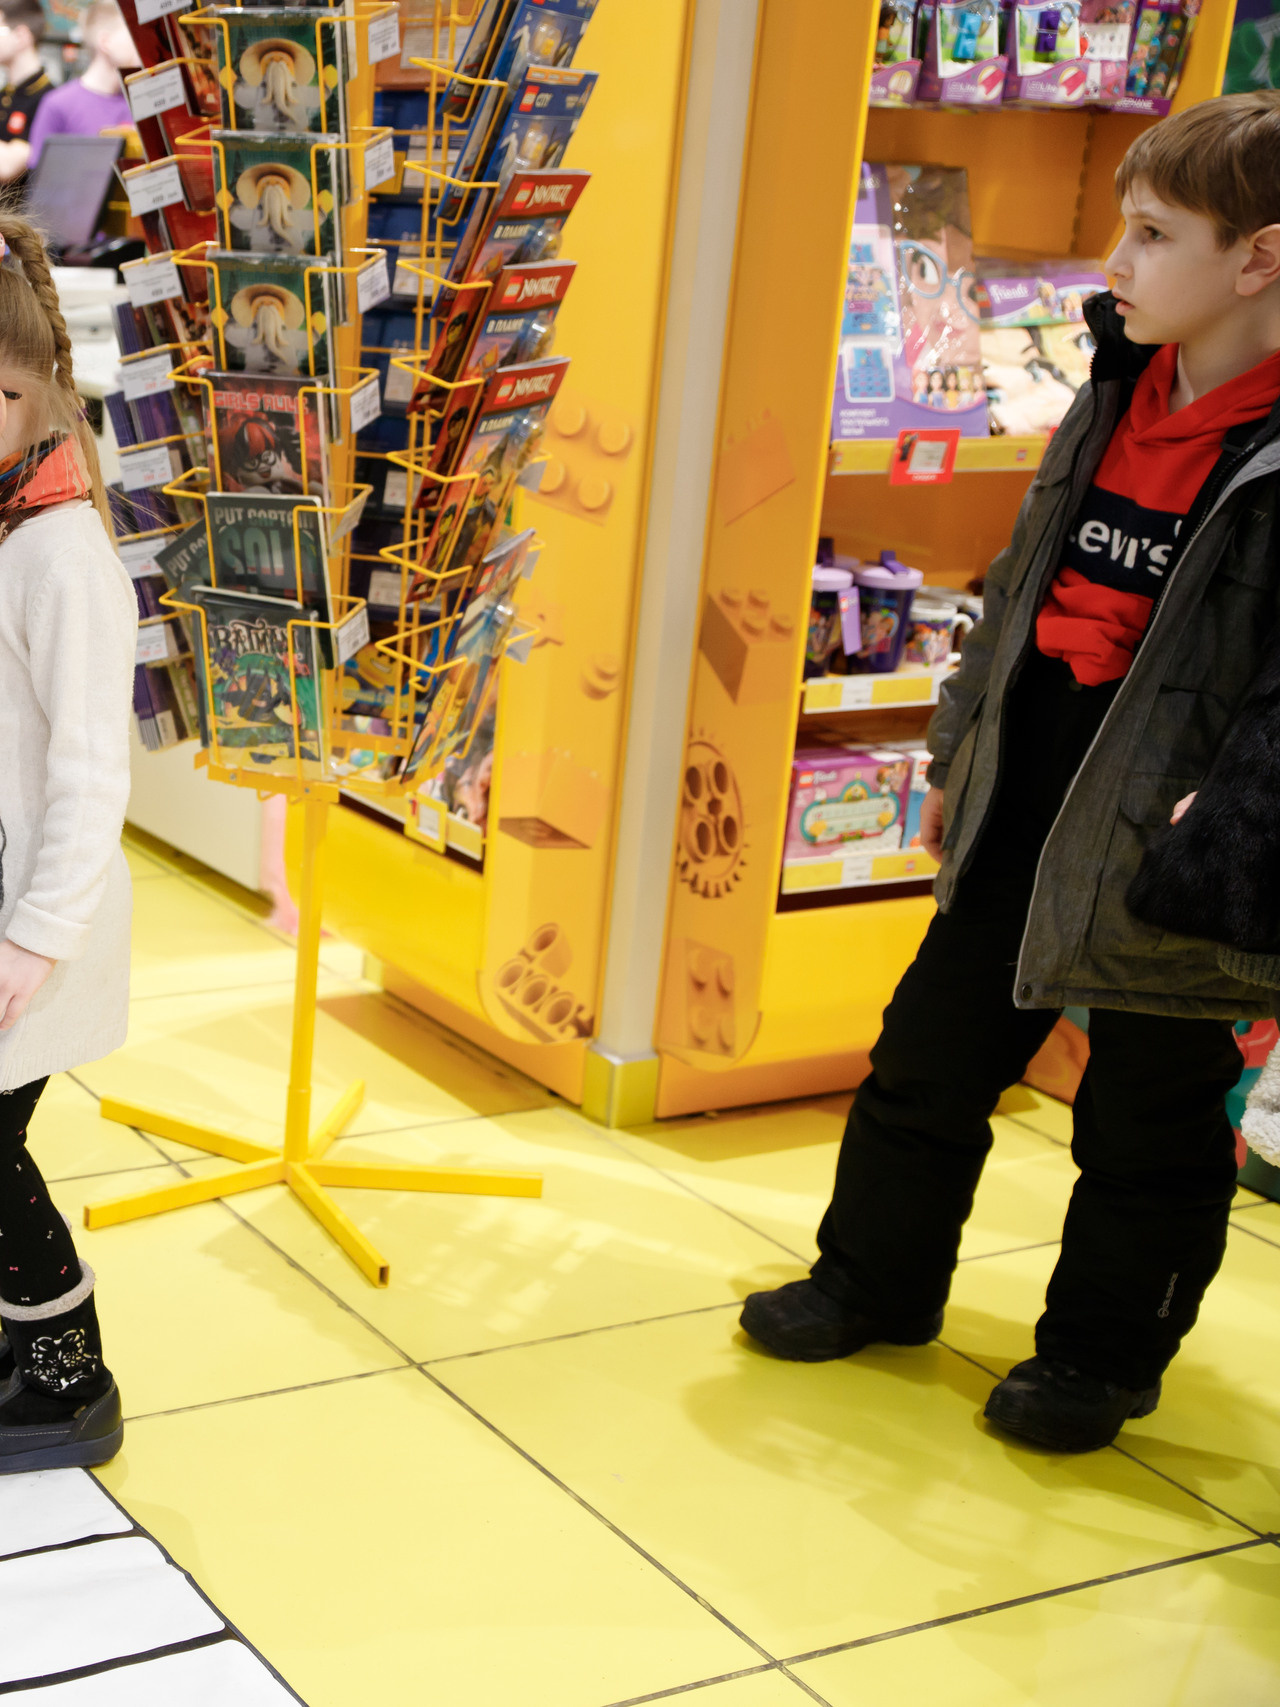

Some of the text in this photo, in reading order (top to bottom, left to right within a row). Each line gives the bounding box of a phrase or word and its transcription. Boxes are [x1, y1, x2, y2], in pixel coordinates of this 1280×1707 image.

[213, 390, 260, 411] GIRLS
[214, 507, 244, 526] PUT
[1068, 519, 1174, 577] evi's
[166, 548, 192, 577] PUT
